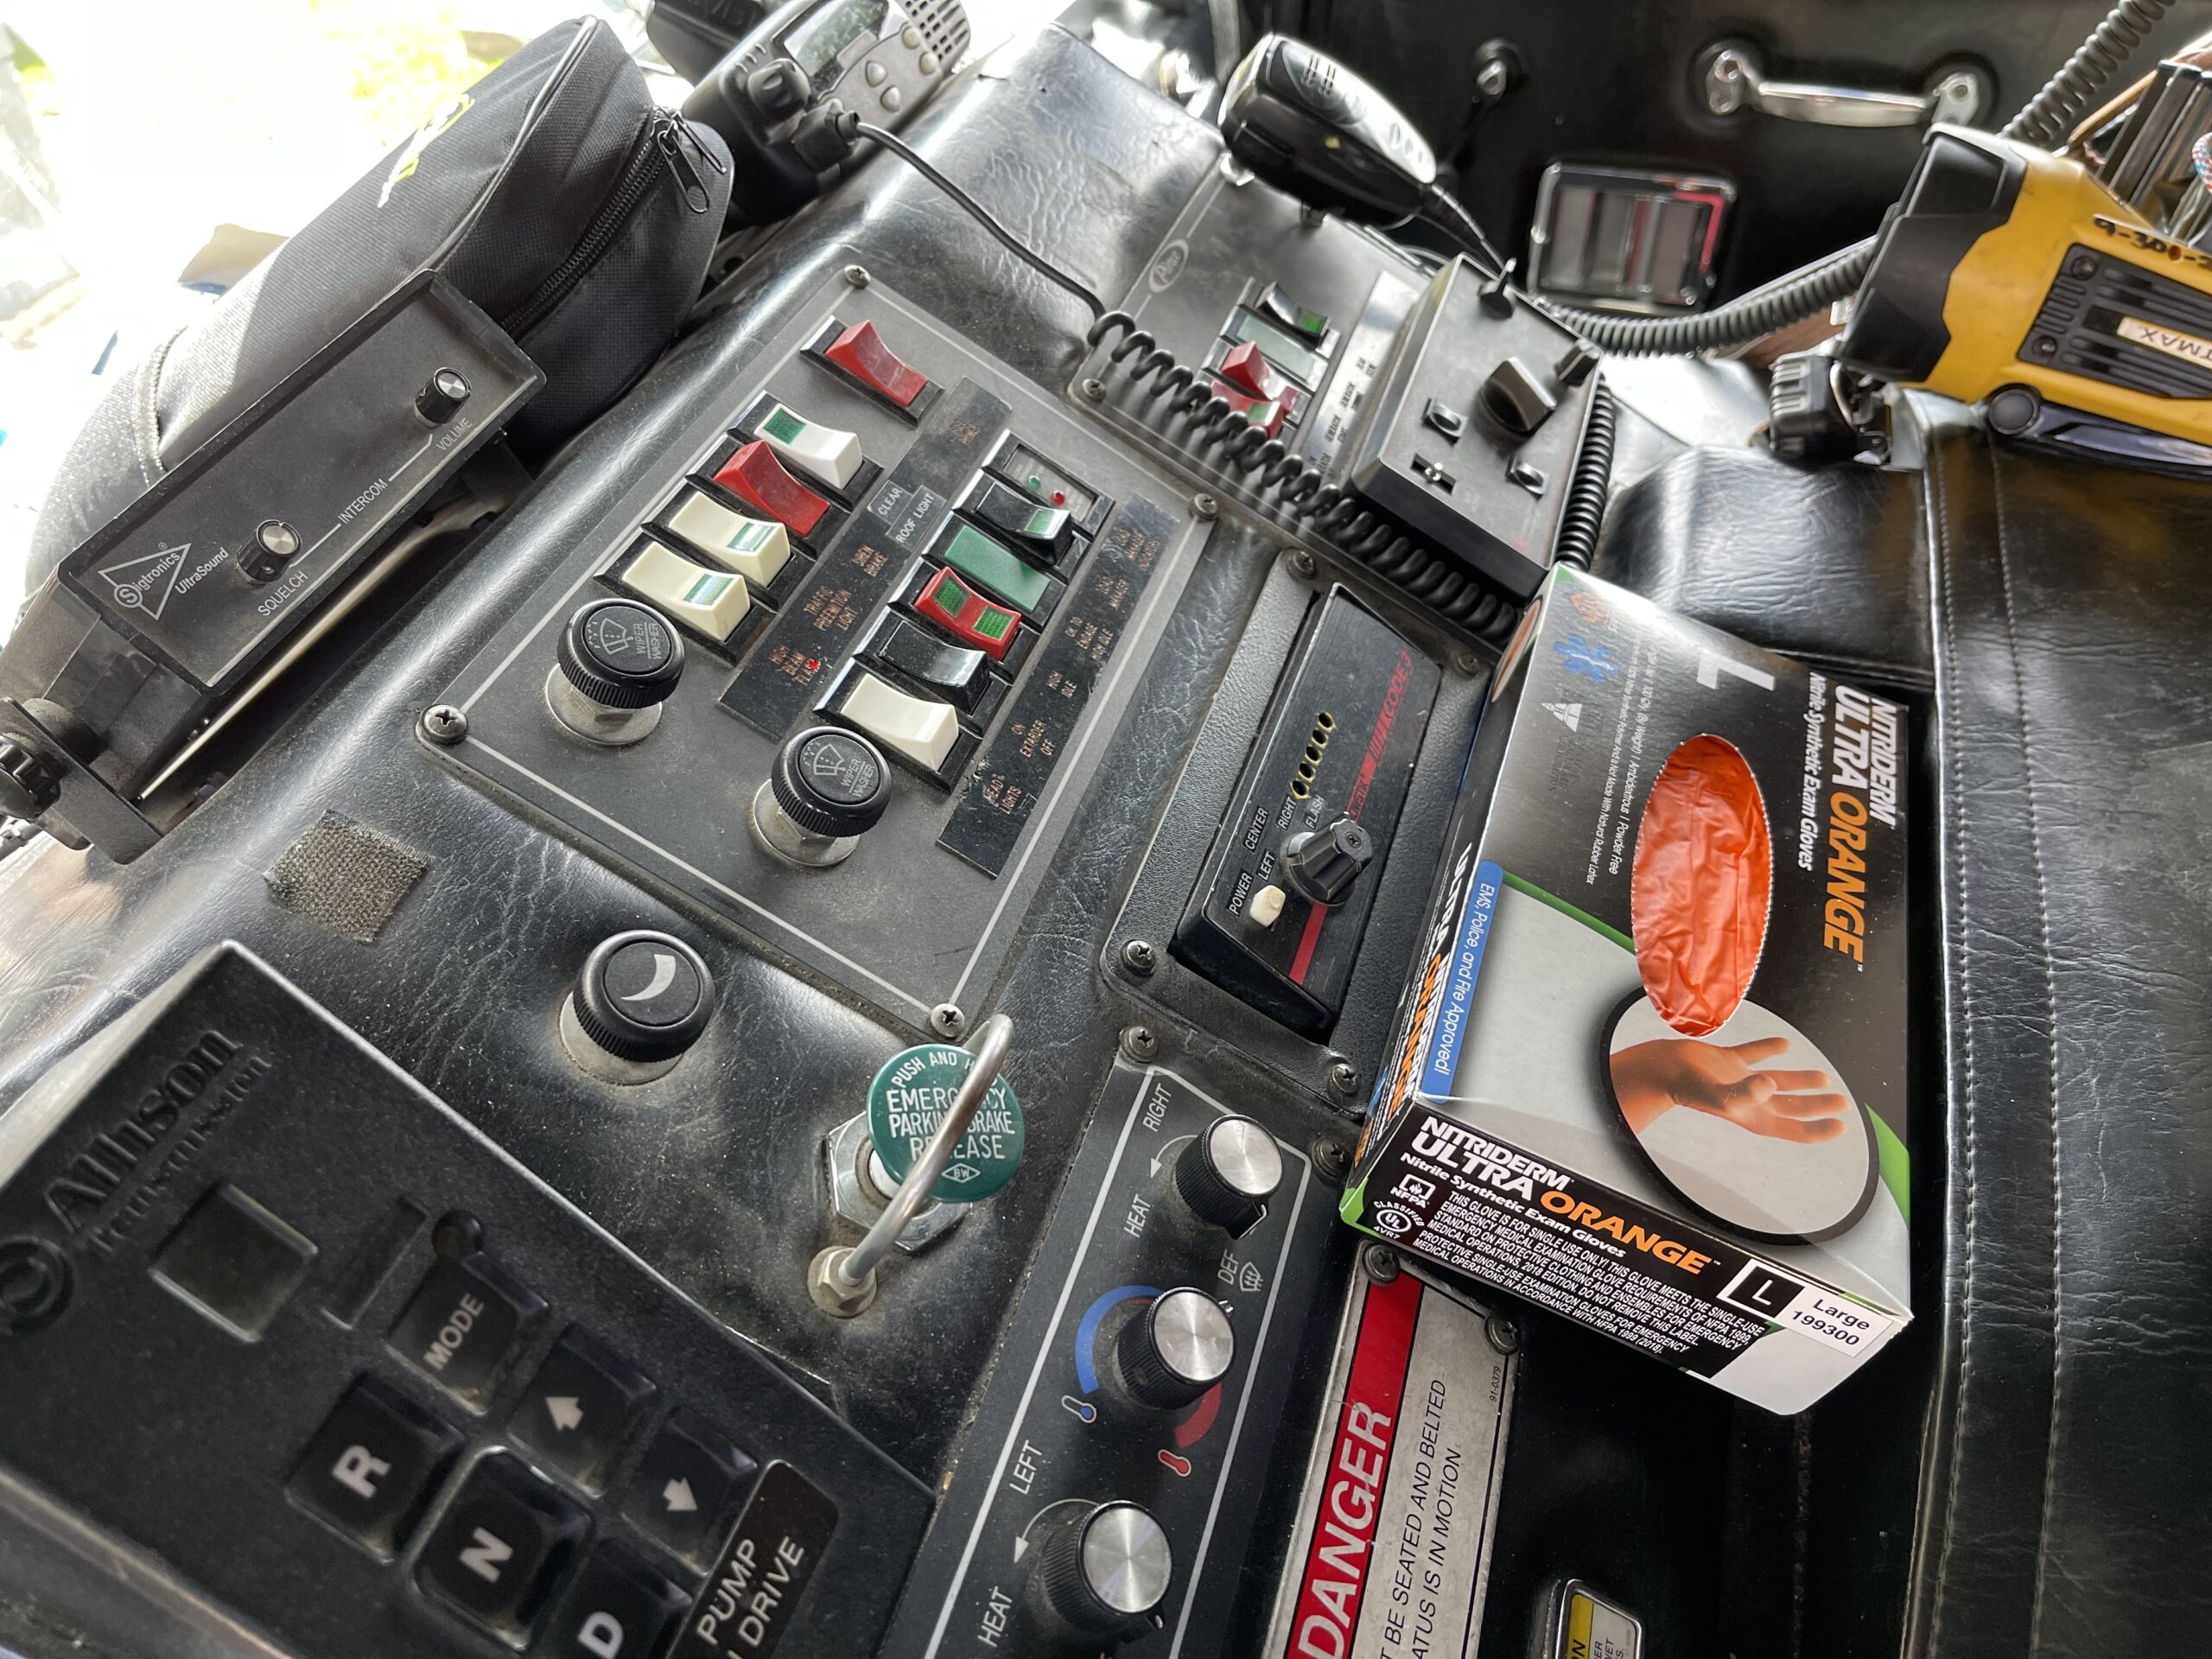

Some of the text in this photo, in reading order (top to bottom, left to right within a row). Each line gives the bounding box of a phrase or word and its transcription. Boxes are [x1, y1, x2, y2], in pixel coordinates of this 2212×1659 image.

[435, 416, 474, 453] VOLUME
[337, 477, 389, 525] INTERCOM
[876, 485, 902, 517] CLEAR
[895, 492, 935, 543] ROOF LIGHT
[118, 548, 183, 607] Sigtronics
[175, 546, 229, 595] UltraSound
[257, 569, 309, 619] SQUELCH
[633, 623, 646, 654] WIPER
[834, 605, 858, 631] LIGHT
[1045, 669, 1064, 690] HIGH
[1059, 677, 1078, 698] IDLE
[1010, 720, 1027, 736] ON
[1039, 737, 1057, 757] OFF
[1831, 685, 1872, 789] ULTRA
[840, 758, 861, 786] WIPER
[1607, 765, 1618, 777] Not
[1610, 745, 1622, 759] And
[1796, 671, 1825, 870] Nitrile Synthetic Exam Gloves
[1867, 698, 1897, 826] NITRIDERM
[852, 764, 875, 798] WASHER
[982, 777, 1005, 803] HEAD
[998, 784, 1022, 815] LIGHTS
[1603, 776, 1616, 796] Made
[1278, 797, 1296, 830] RIGHT
[1305, 793, 1325, 829] FLASH
[1594, 811, 1609, 838] Natural
[1600, 797, 1612, 812] With
[1607, 760, 1640, 874] Ambidextrous Powder Free
[1244, 807, 1269, 850] CENTER
[1589, 837, 1604, 863] Rubber
[1257, 851, 1275, 880] LEFT
[1585, 863, 1599, 884] Latex
[1229, 872, 1252, 915] POWER
[1432, 883, 1494, 1075] EMS, Police, and Fire Approved!
[891, 1052, 957, 1088] PUSH AND
[887, 1087, 1006, 1113] EMERGCY
[1142, 1083, 1172, 1132] RIGHT
[953, 1167, 970, 1178] BW
[1406, 1130, 1544, 1201] ULTRA
[1419, 1116, 1576, 1191] NITRIDERM
[1124, 1193, 1151, 1237] HEAT
[1370, 1194, 1430, 1228] CLASSIFIED
[1388, 1185, 1430, 1209] NFPA
[1398, 1152, 1628, 1258] Nitrile Synthetic Exam Gloves
[1372, 1224, 1401, 1240] 4VR7
[1381, 1211, 1406, 1230] UL
[1217, 1249, 1239, 1285] DEF
[1425, 1218, 1702, 1347] MEDICAL OPERATIONS, 2018 EDITION. DO NOT REMOVE THIS LABEL.
[1432, 1210, 1743, 1352] STANDARD ON PROTECTIVE CLOTHING AND ENSEMBLES FOR EMERGENCY
[1439, 1200, 1753, 1344] EMERGENCY MEDICAL EXAMINATION GLOVE REQUIREMENTS OF NFPA 1999,
[1446, 1191, 1766, 1337] THIS GLOVE IS FOR SINGLE USE ONLY! THIS GLOVE MEETS THE SINGLE-USE
[1411, 1236, 1665, 1356] MEDICAL OPERATIONS IN ACCORDANCE WITH NFPA 1999 (2018).
[1417, 1229, 1690, 1356] PROTECTIVE SINGLE-USE EXAMINATION GLOVES FOR EMERGENCY
[1751, 1277, 1783, 1306] L
[423, 1292, 486, 1371] MODE
[1789, 1309, 1862, 1347] 199300
[1808, 1297, 1874, 1333] Large
[1490, 1365, 1501, 1402] 91-0379
[1420, 1379, 1446, 1459] BELTED
[331, 1443, 391, 1498] R
[1009, 1439, 1042, 1495] LEFT
[1411, 1461, 1431, 1510] AND
[1298, 1402, 1391, 1659] DANGER
[1423, 1448, 1461, 1595] IS IN MOTION
[460, 1526, 514, 1583] N
[1392, 1514, 1422, 1605] SEATED
[696, 1539, 756, 1645] PUMP
[739, 1535, 804, 1648] DRIVE
[577, 1611, 625, 1657] D
[977, 1586, 1013, 1647] HEAT
[1385, 1609, 1406, 1645] BE
